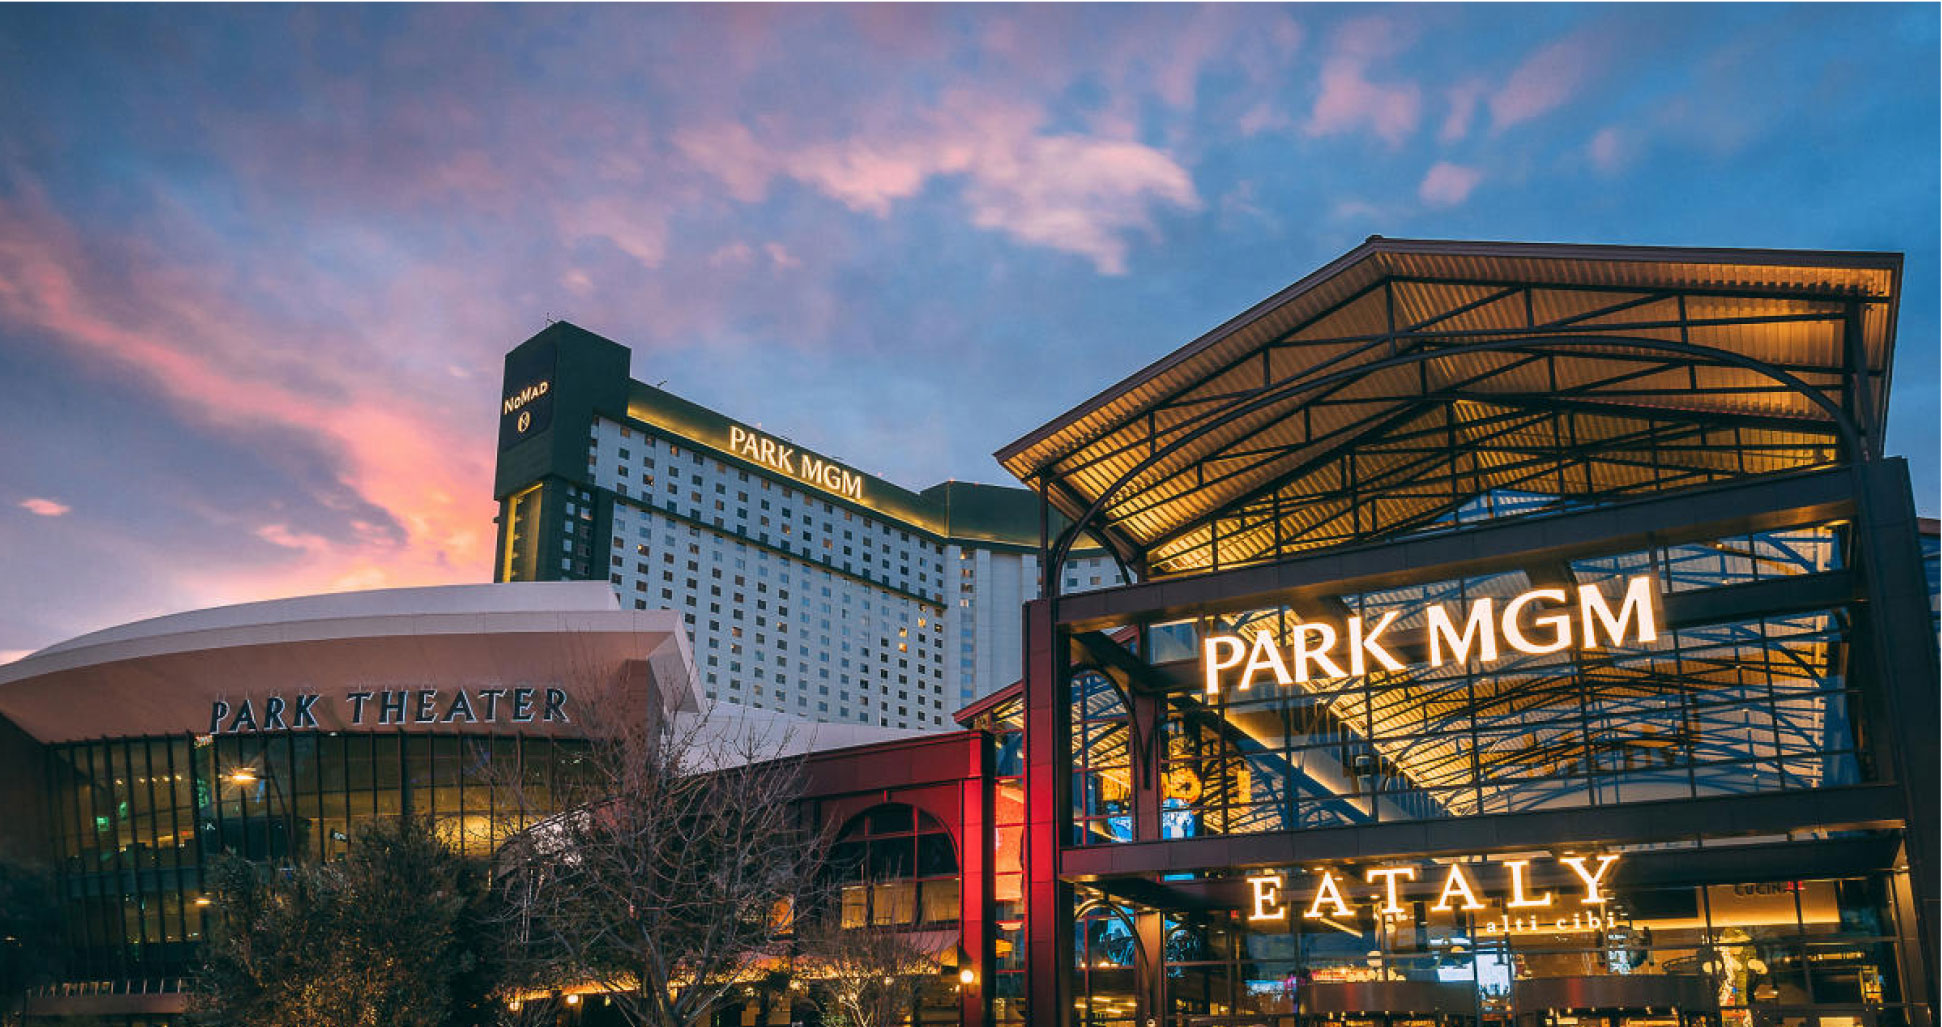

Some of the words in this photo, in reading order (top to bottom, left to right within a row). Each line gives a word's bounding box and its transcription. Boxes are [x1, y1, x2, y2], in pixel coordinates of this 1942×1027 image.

[729, 425, 794, 474] PARK
[801, 454, 862, 500] MGM
[1204, 610, 1406, 694] PARK
[1426, 576, 1657, 668] MGM
[210, 694, 320, 735] PARK
[346, 688, 570, 725] THEATER
[1247, 854, 1620, 921] EATALY
[1486, 914, 1538, 933] alti
[1555, 911, 1616, 930] cibi
